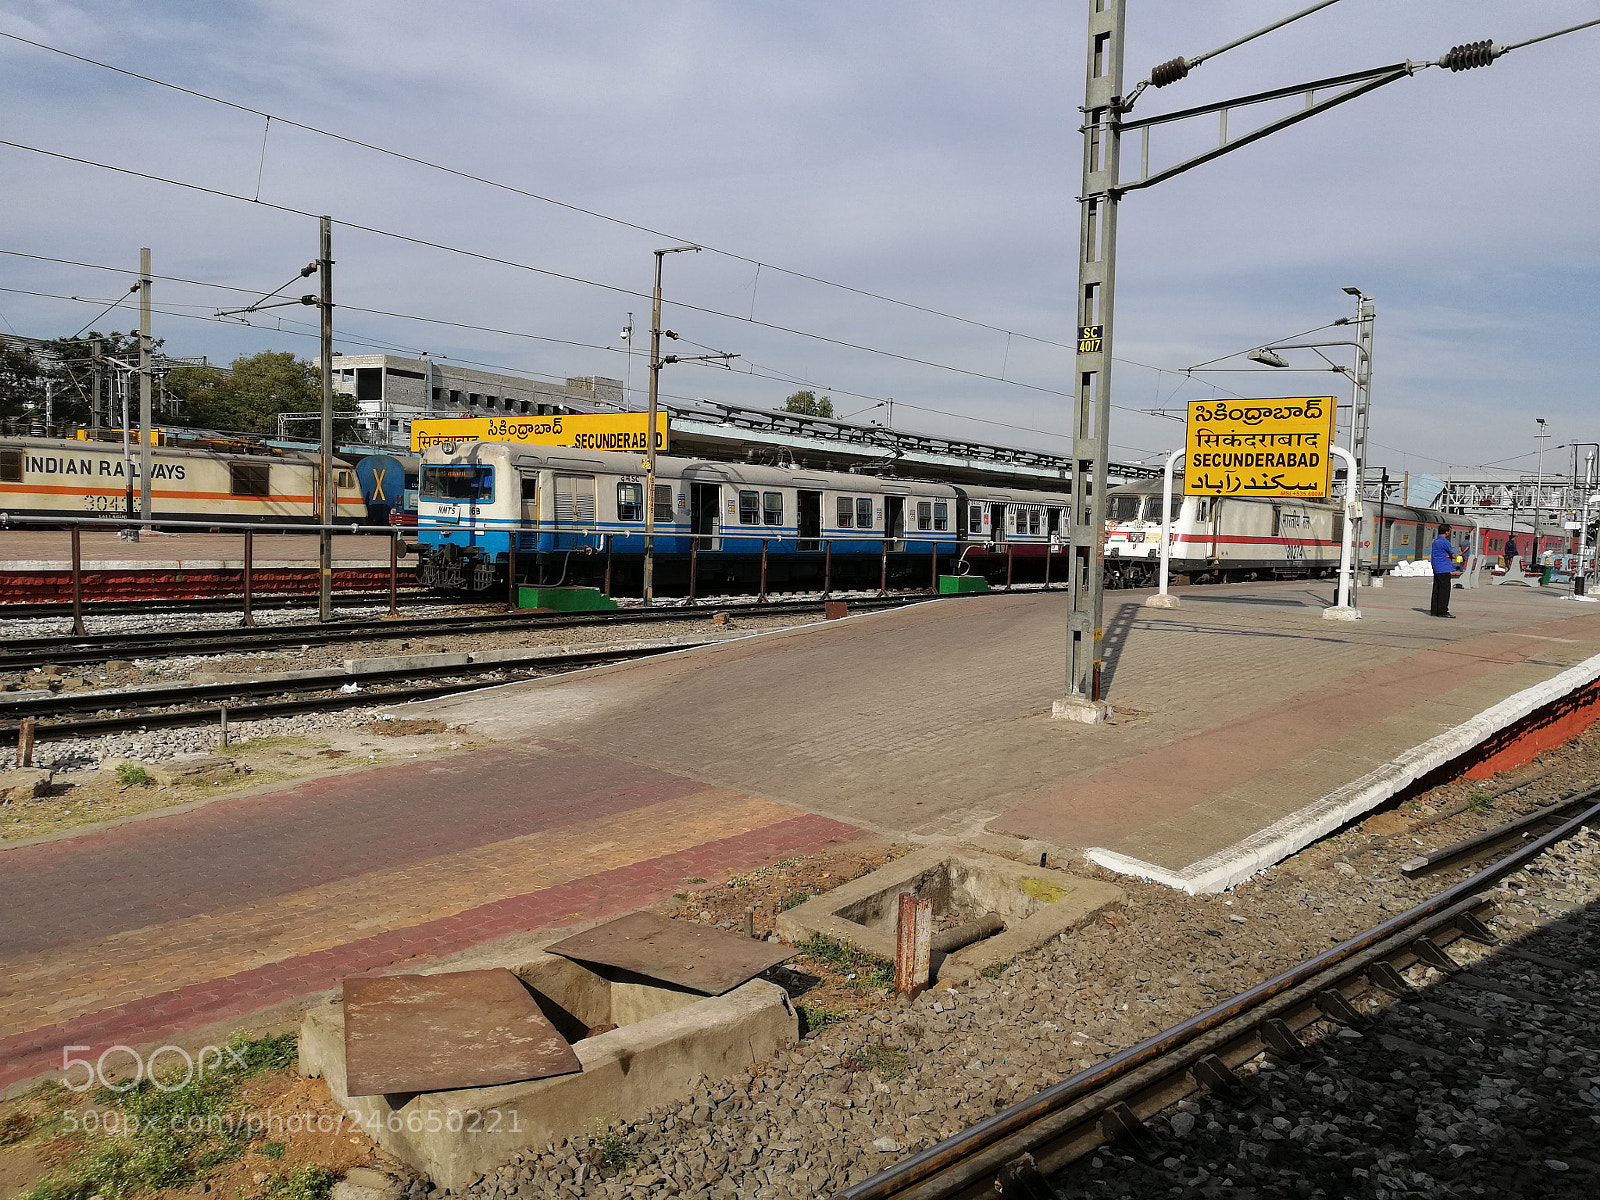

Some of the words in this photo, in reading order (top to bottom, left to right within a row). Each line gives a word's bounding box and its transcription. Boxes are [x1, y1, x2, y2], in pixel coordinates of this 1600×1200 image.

[1083, 326, 1098, 339] SC
[1080, 339, 1101, 353] 4017
[1195, 399, 1323, 426] సికింద్రాబాద్
[487, 417, 563, 440] సికింద్రాబాద్
[1194, 428, 1320, 449] सिकंदराबाद
[574, 432, 663, 449] SECUNDERABD
[25, 456, 92, 475] INDIAN
[99, 460, 186, 480] RALAYS
[1193, 452, 1320, 468] SECUNDERABAD
[372, 468, 386, 501] X
